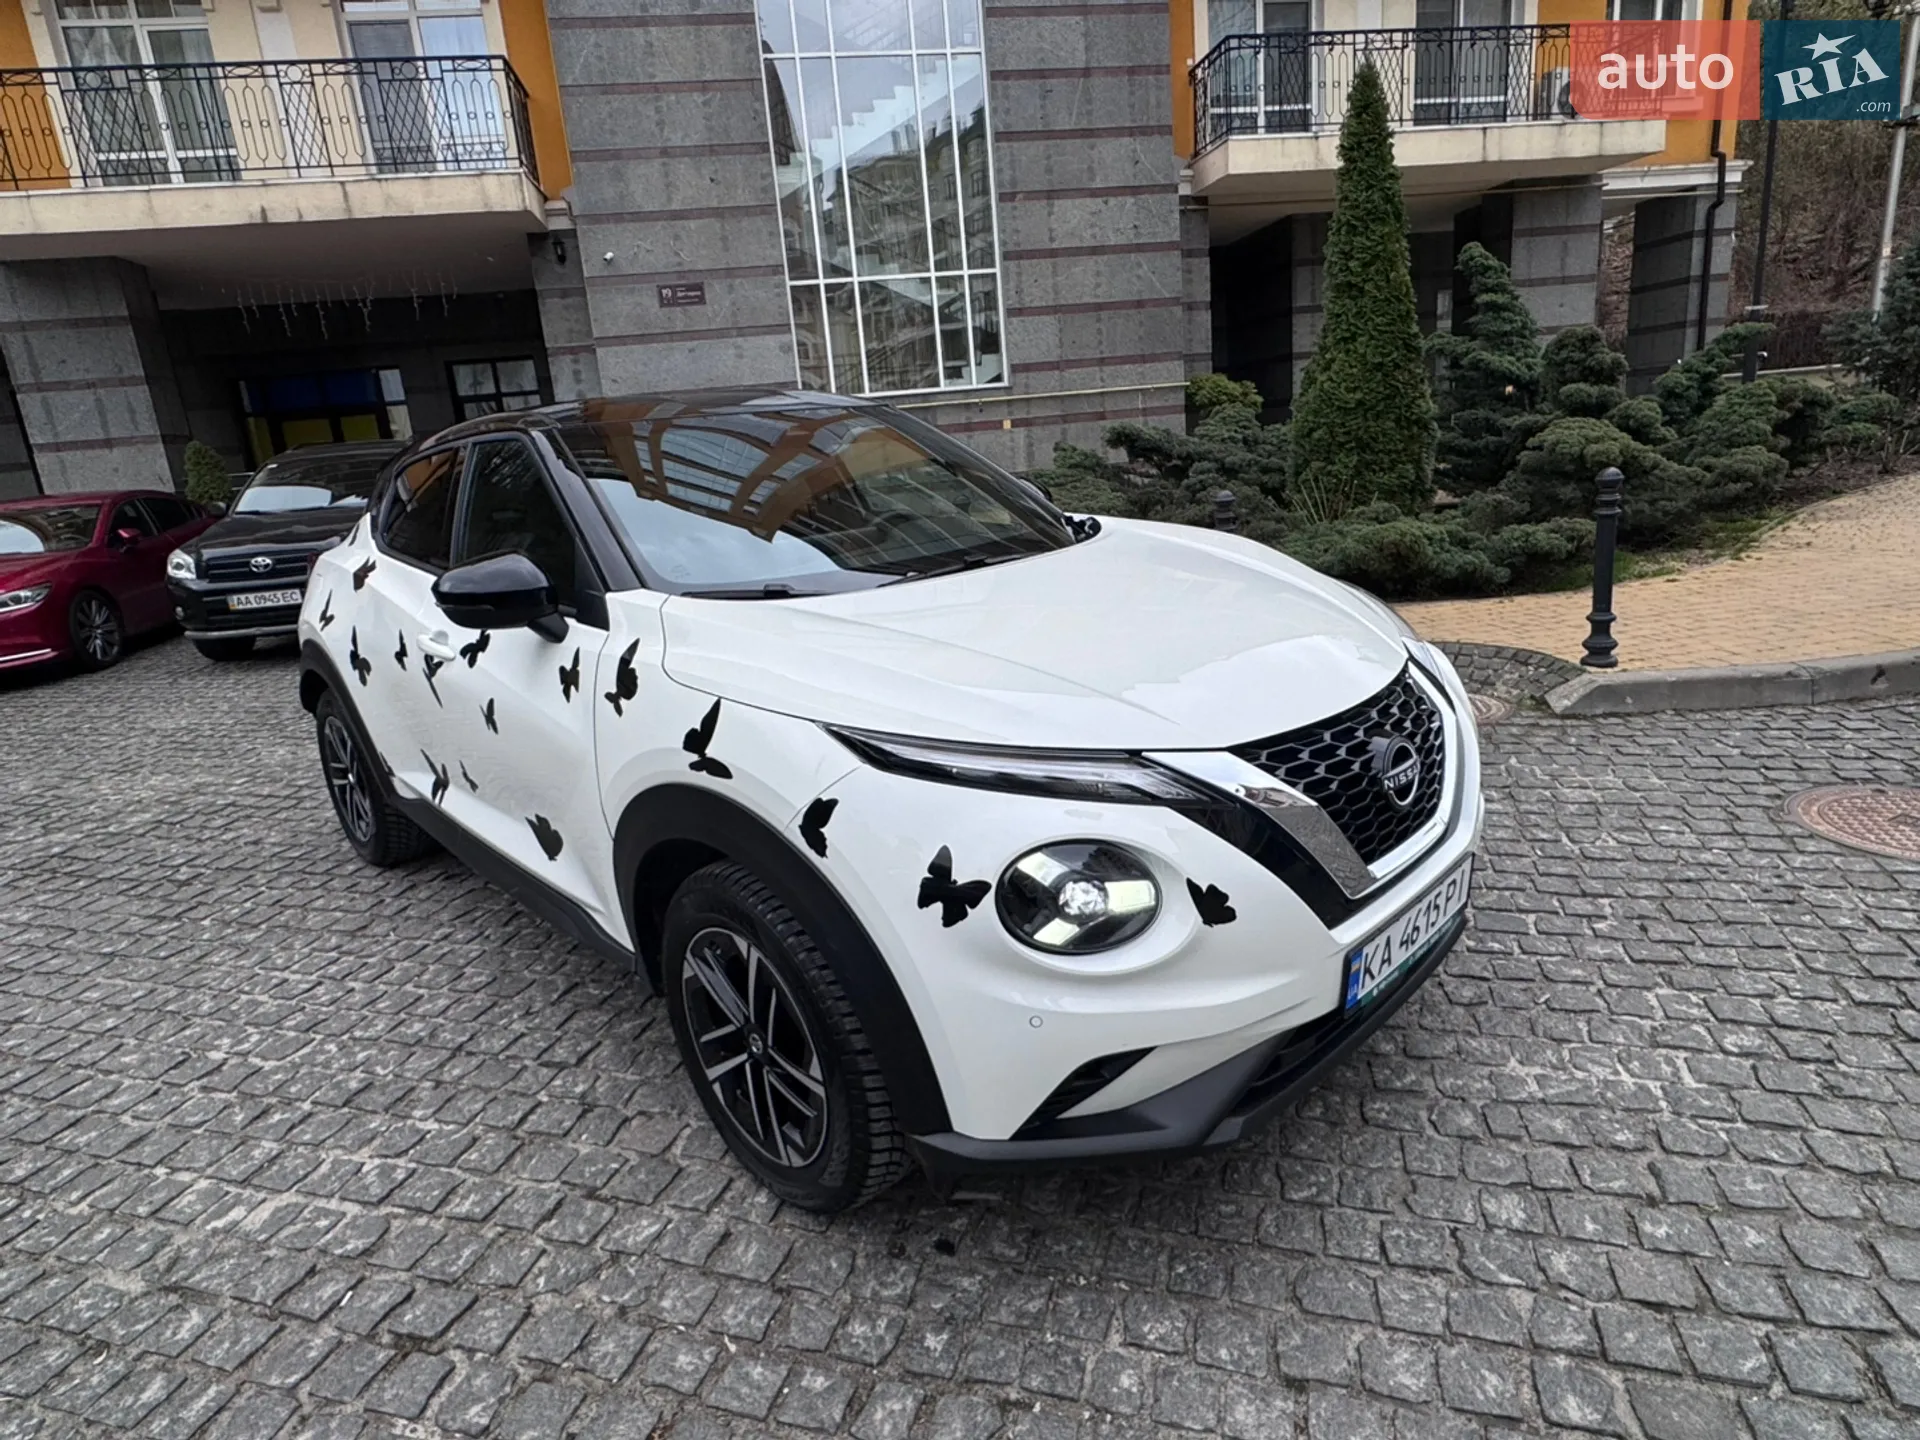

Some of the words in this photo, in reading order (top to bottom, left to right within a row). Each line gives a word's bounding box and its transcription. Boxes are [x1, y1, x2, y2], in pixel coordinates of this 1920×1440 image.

[237, 596, 253, 607] AA
[253, 592, 280, 605] 0945
[281, 590, 299, 603] EC
[1361, 934, 1392, 990] KA
[1399, 890, 1442, 952] 4615
[1443, 868, 1466, 917] PI
